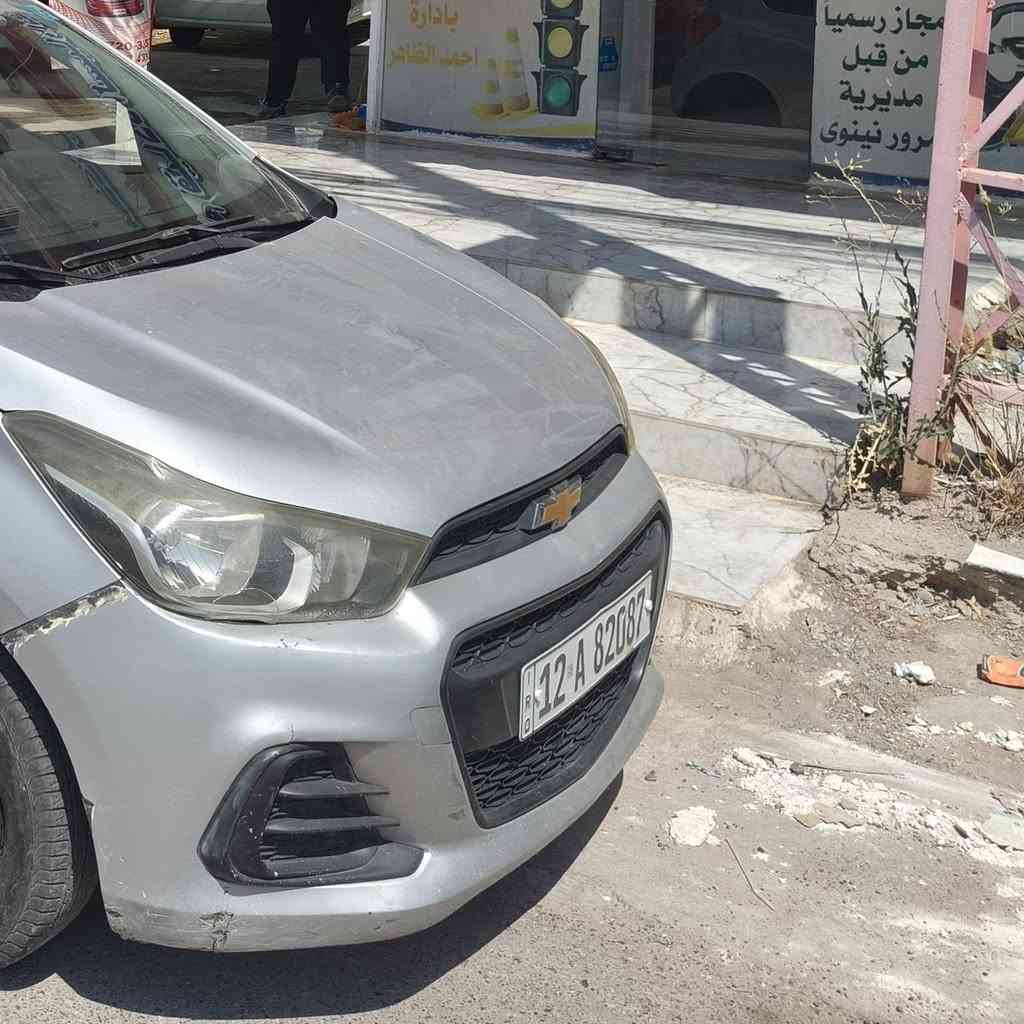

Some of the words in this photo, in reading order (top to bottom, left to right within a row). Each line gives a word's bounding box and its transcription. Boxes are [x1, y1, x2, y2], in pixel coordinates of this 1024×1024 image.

[890, 5, 945, 37] مجاز
[842, 43, 888, 72] قبل
[893, 49, 929, 75] من
[839, 80, 923, 112] مديرية
[538, 653, 567, 720] 12
[573, 637, 585, 693] A
[593, 587, 647, 675] 82087
